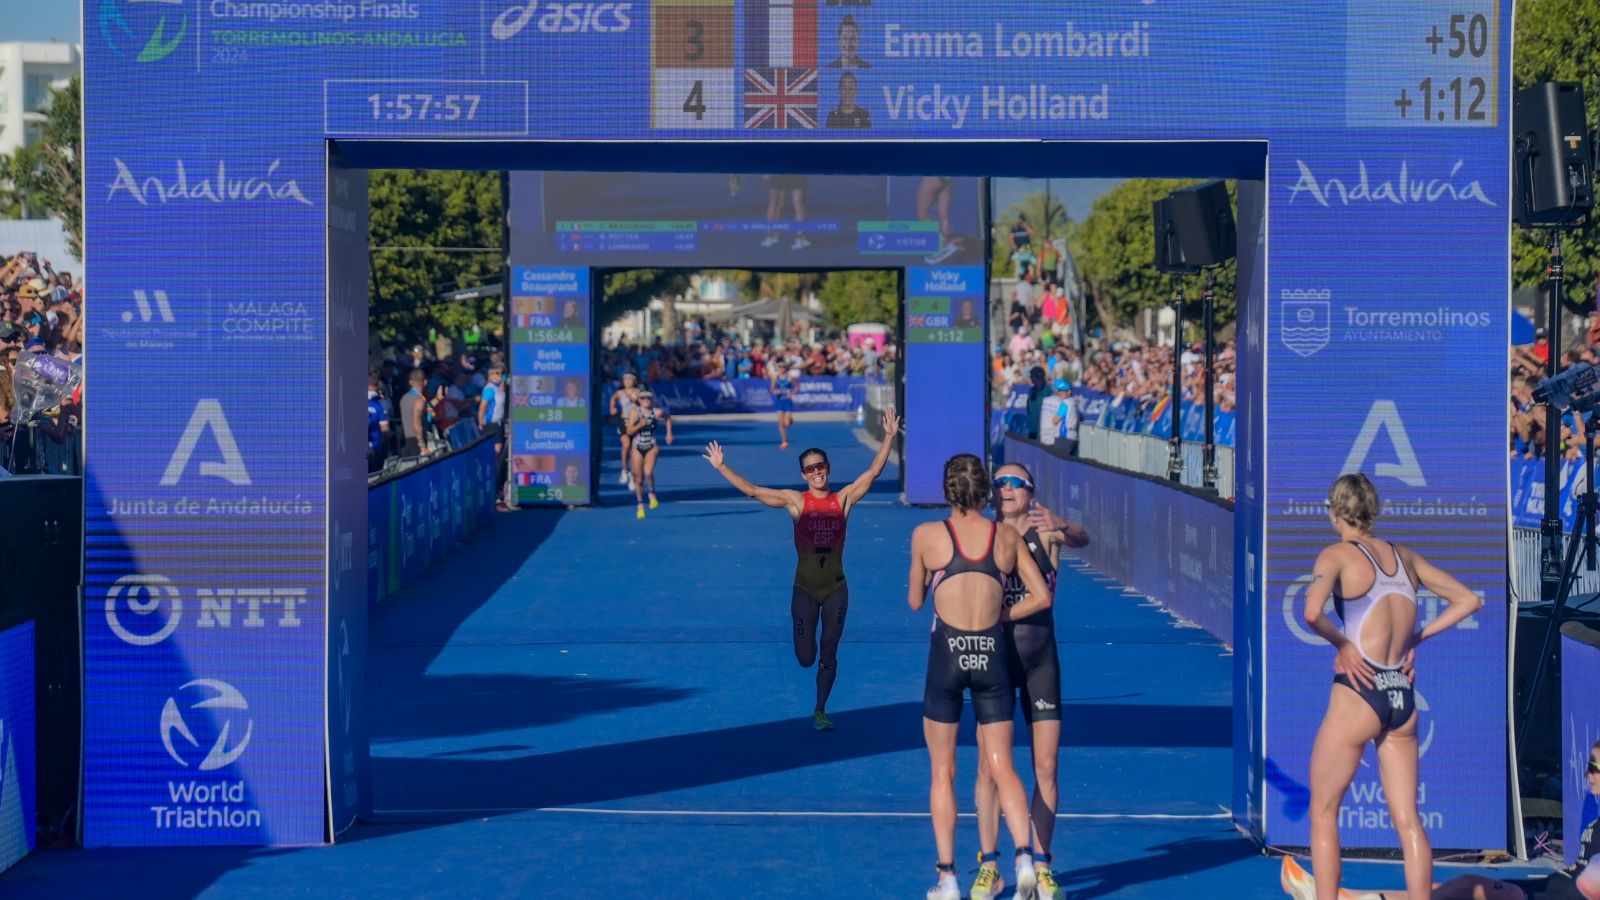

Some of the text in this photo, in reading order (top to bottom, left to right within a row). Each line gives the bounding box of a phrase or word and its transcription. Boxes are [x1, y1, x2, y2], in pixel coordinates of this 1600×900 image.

[209, 0, 419, 21] Championship Finals
[537, 2, 632, 33] asics
[684, 13, 1488, 61] 3 Emma Lombardi +50
[210, 49, 248, 63] 2024
[368, 94, 481, 120] 1:57:57
[683, 76, 1486, 128] 4 Vicky Holland +1:12
[106, 157, 313, 206] Andalucía
[1287, 159, 1497, 207] Andalucía
[523, 271, 576, 280] Cassandre
[931, 270, 960, 282] Vicky
[521, 281, 577, 293] Beaugrand
[925, 281, 966, 291] Holland
[530, 316, 551, 327] FRA
[926, 316, 949, 326] GBR
[1343, 307, 1491, 327] Torremolinos
[222, 317, 314, 333] COMPITE
[528, 331, 573, 342] 1:56:44
[928, 330, 964, 342] +1:12
[1343, 330, 1442, 341] AYUNTAMIENTO
[538, 349, 562, 359] Beth
[533, 361, 566, 371] Potter
[530, 395, 552, 405] GBR
[537, 409, 562, 421] +38
[534, 429, 566, 438] Emma
[525, 440, 575, 449] Lombardi
[530, 475, 552, 484] FRA
[538, 489, 563, 501] +50
[107, 495, 313, 515] Junta de Andalucía
[1381, 496, 1488, 516] Andalucía
[808, 519, 840, 532] CASILLAS
[814, 532, 834, 545] ESP
[196, 588, 307, 628] NTT
[948, 636, 995, 653] POTTER
[958, 655, 989, 671] GBR
[168, 782, 244, 803] World
[1350, 781, 1426, 804] Wod
[151, 807, 261, 829] Triathlon
